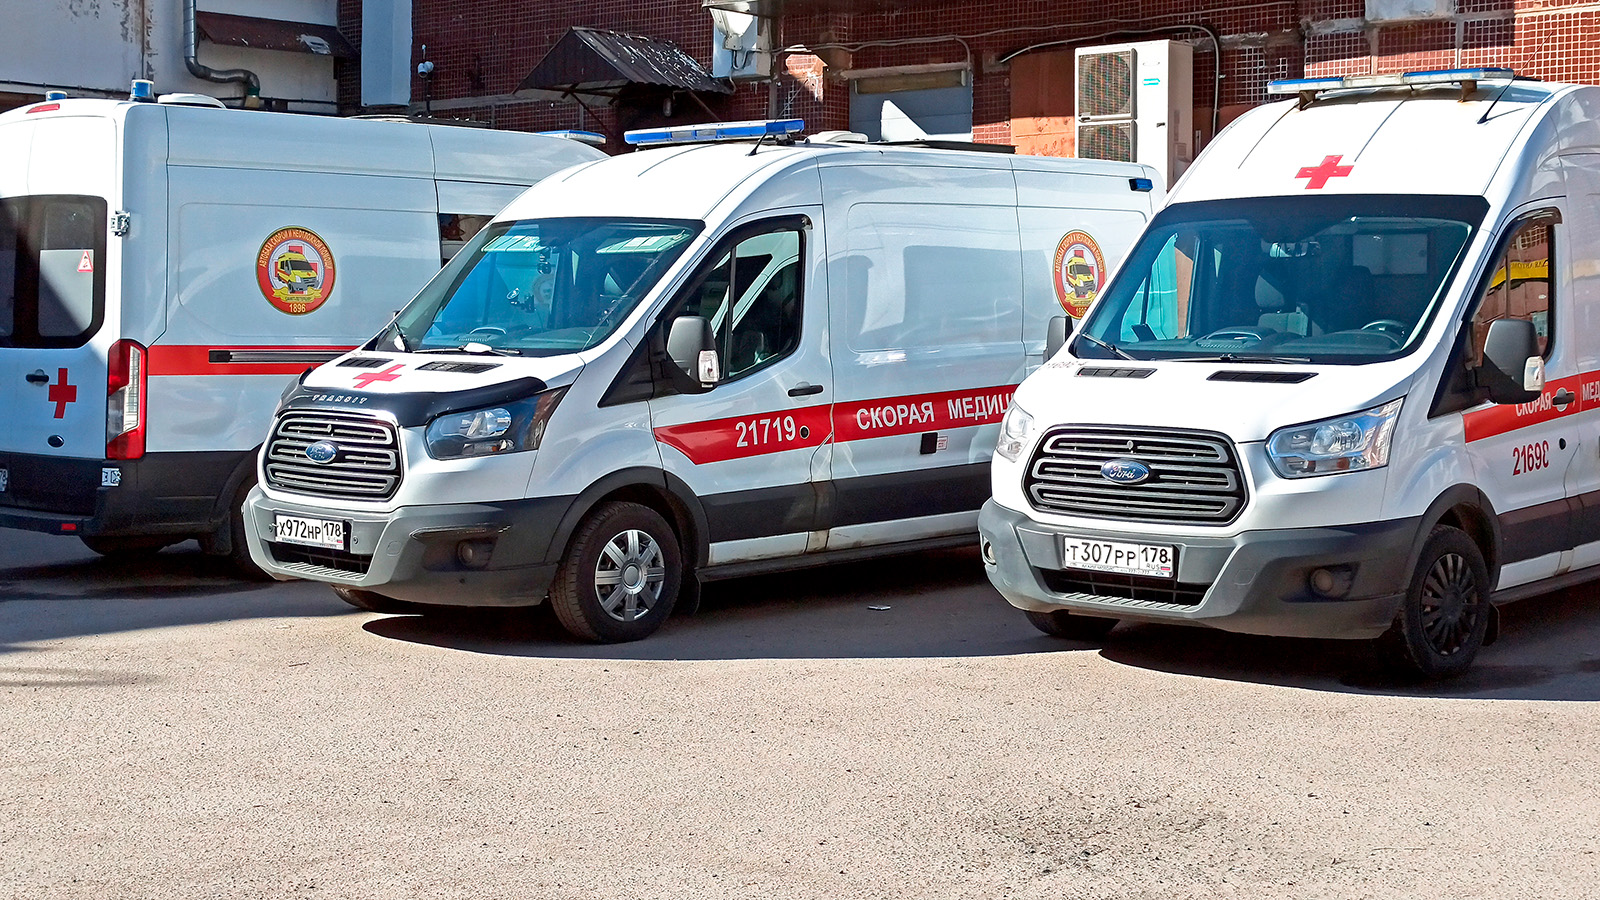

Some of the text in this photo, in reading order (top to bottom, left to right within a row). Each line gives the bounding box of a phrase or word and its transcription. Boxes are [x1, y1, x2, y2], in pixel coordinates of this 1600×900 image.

[259, 241, 274, 267] АВТОБАЗА
[270, 230, 288, 246] СКОРОЙ
[292, 229, 323, 249] НЕОТЛОЖНОЙ
[318, 245, 332, 269] ПОМОЩИ
[289, 303, 306, 313] 1896
[311, 394, 368, 404] TRANSIT
[856, 401, 935, 430] СКОРАЯ
[735, 415, 796, 448] 21719
[1110, 465, 1137, 479] Ford
[323, 522, 341, 537] 178
[1141, 547, 1168, 564] 178
